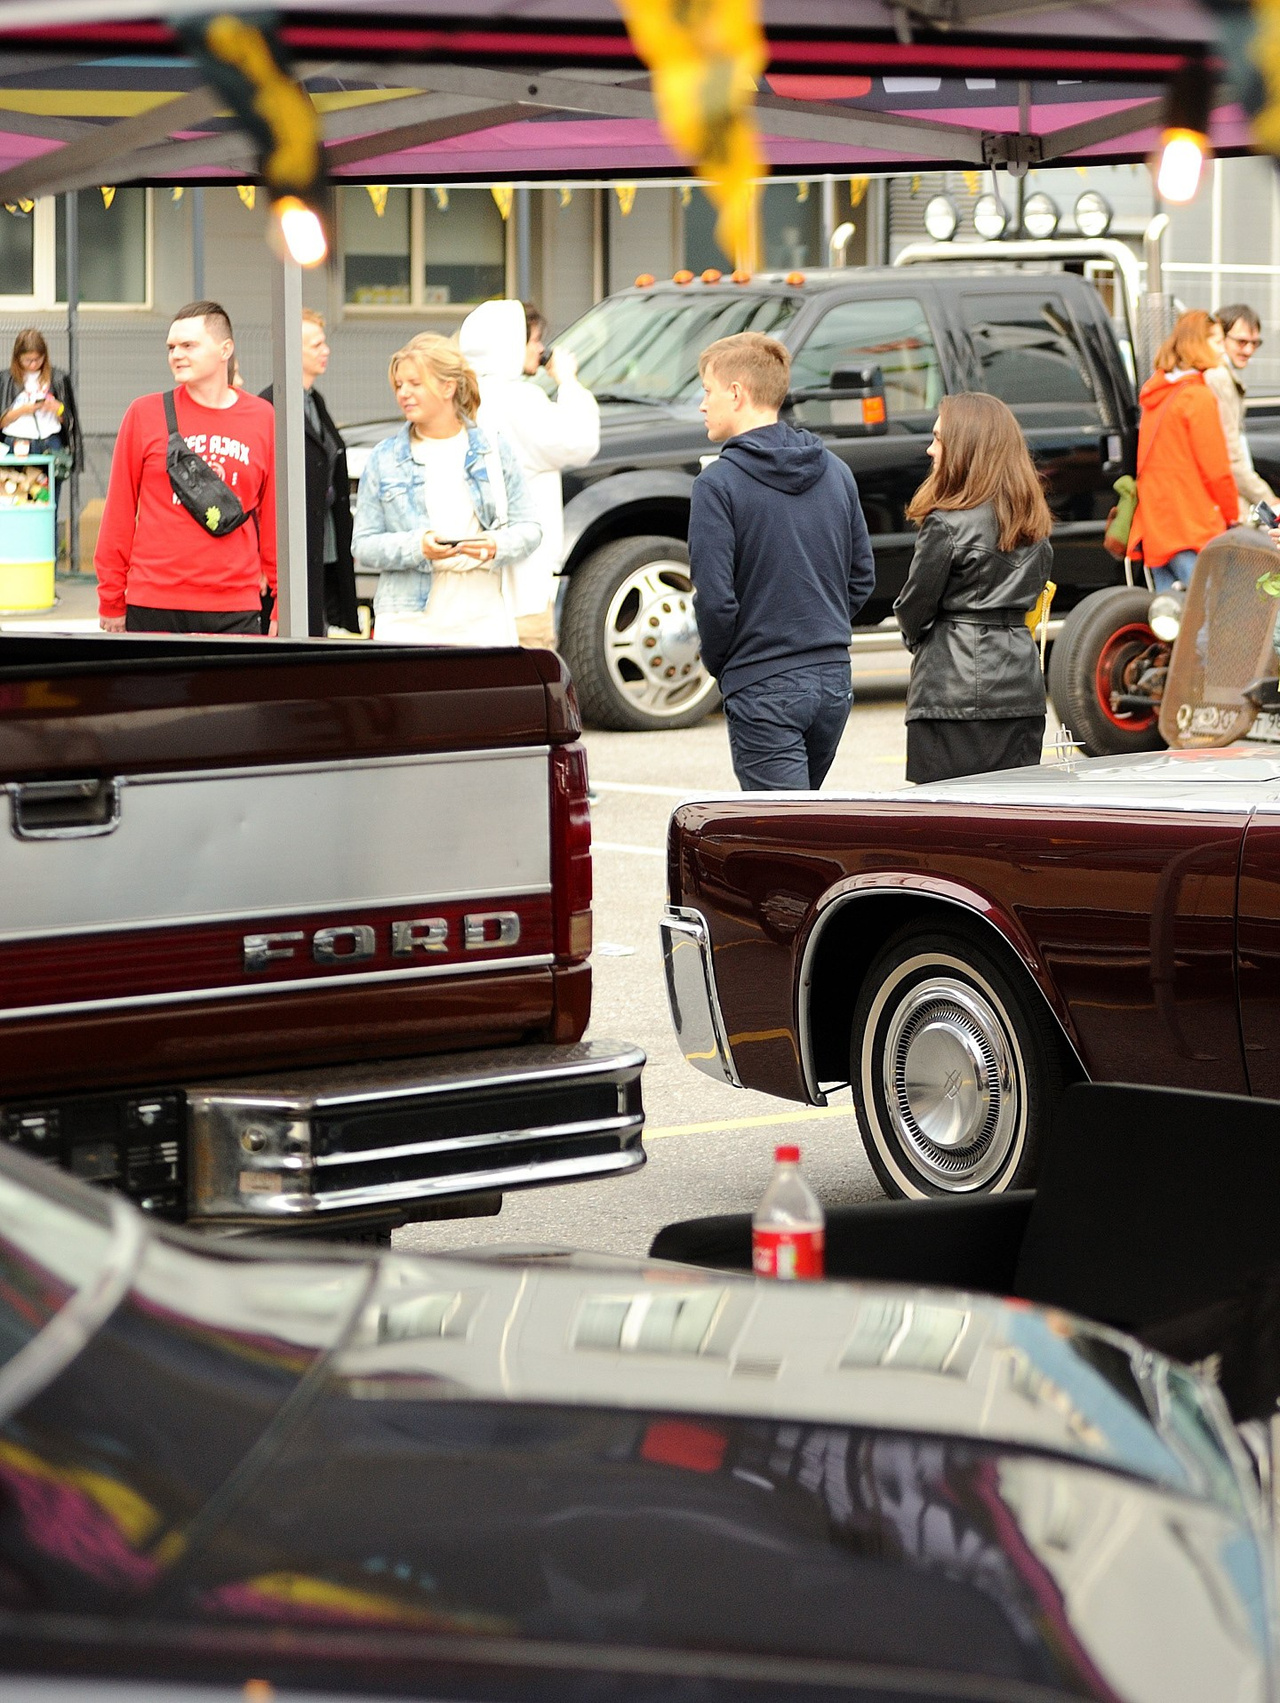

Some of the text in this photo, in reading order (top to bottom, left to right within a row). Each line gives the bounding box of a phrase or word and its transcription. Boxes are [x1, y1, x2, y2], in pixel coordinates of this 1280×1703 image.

[183, 434, 250, 466] FC AJAX
[243, 911, 521, 972] FORD
